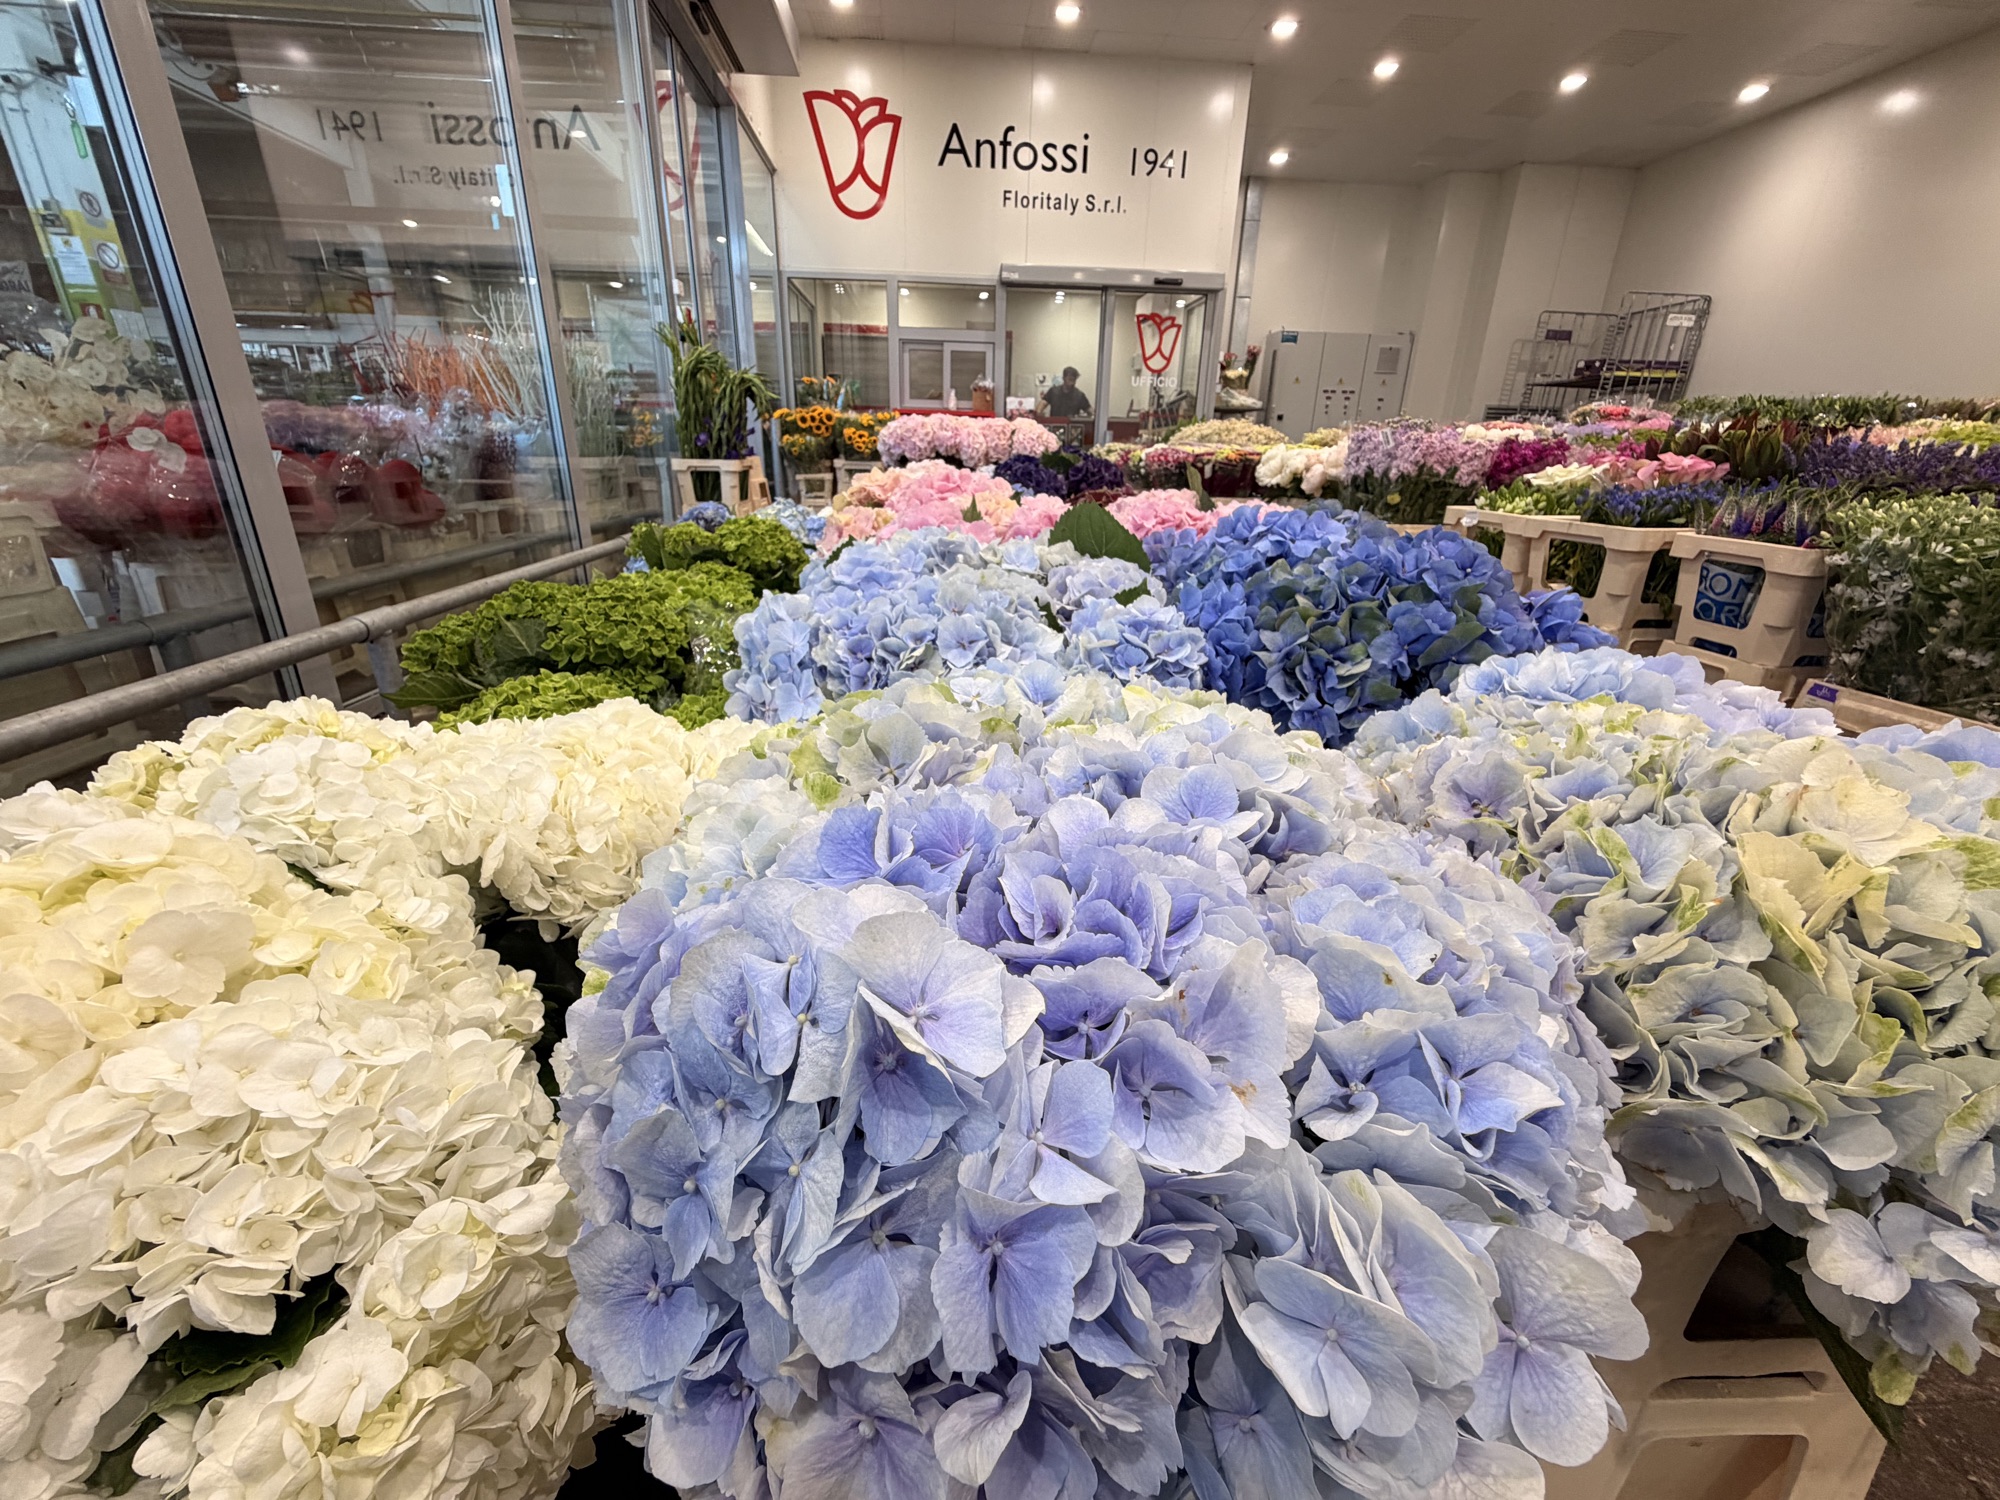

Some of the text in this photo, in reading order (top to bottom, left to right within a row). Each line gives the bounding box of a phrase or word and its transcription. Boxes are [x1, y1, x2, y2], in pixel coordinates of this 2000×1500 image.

[937, 122, 1188, 179] Anfossi 1941
[1002, 190, 1127, 216] Floritaly S.r.l.
[1131, 375, 1178, 388] UFFICIO
